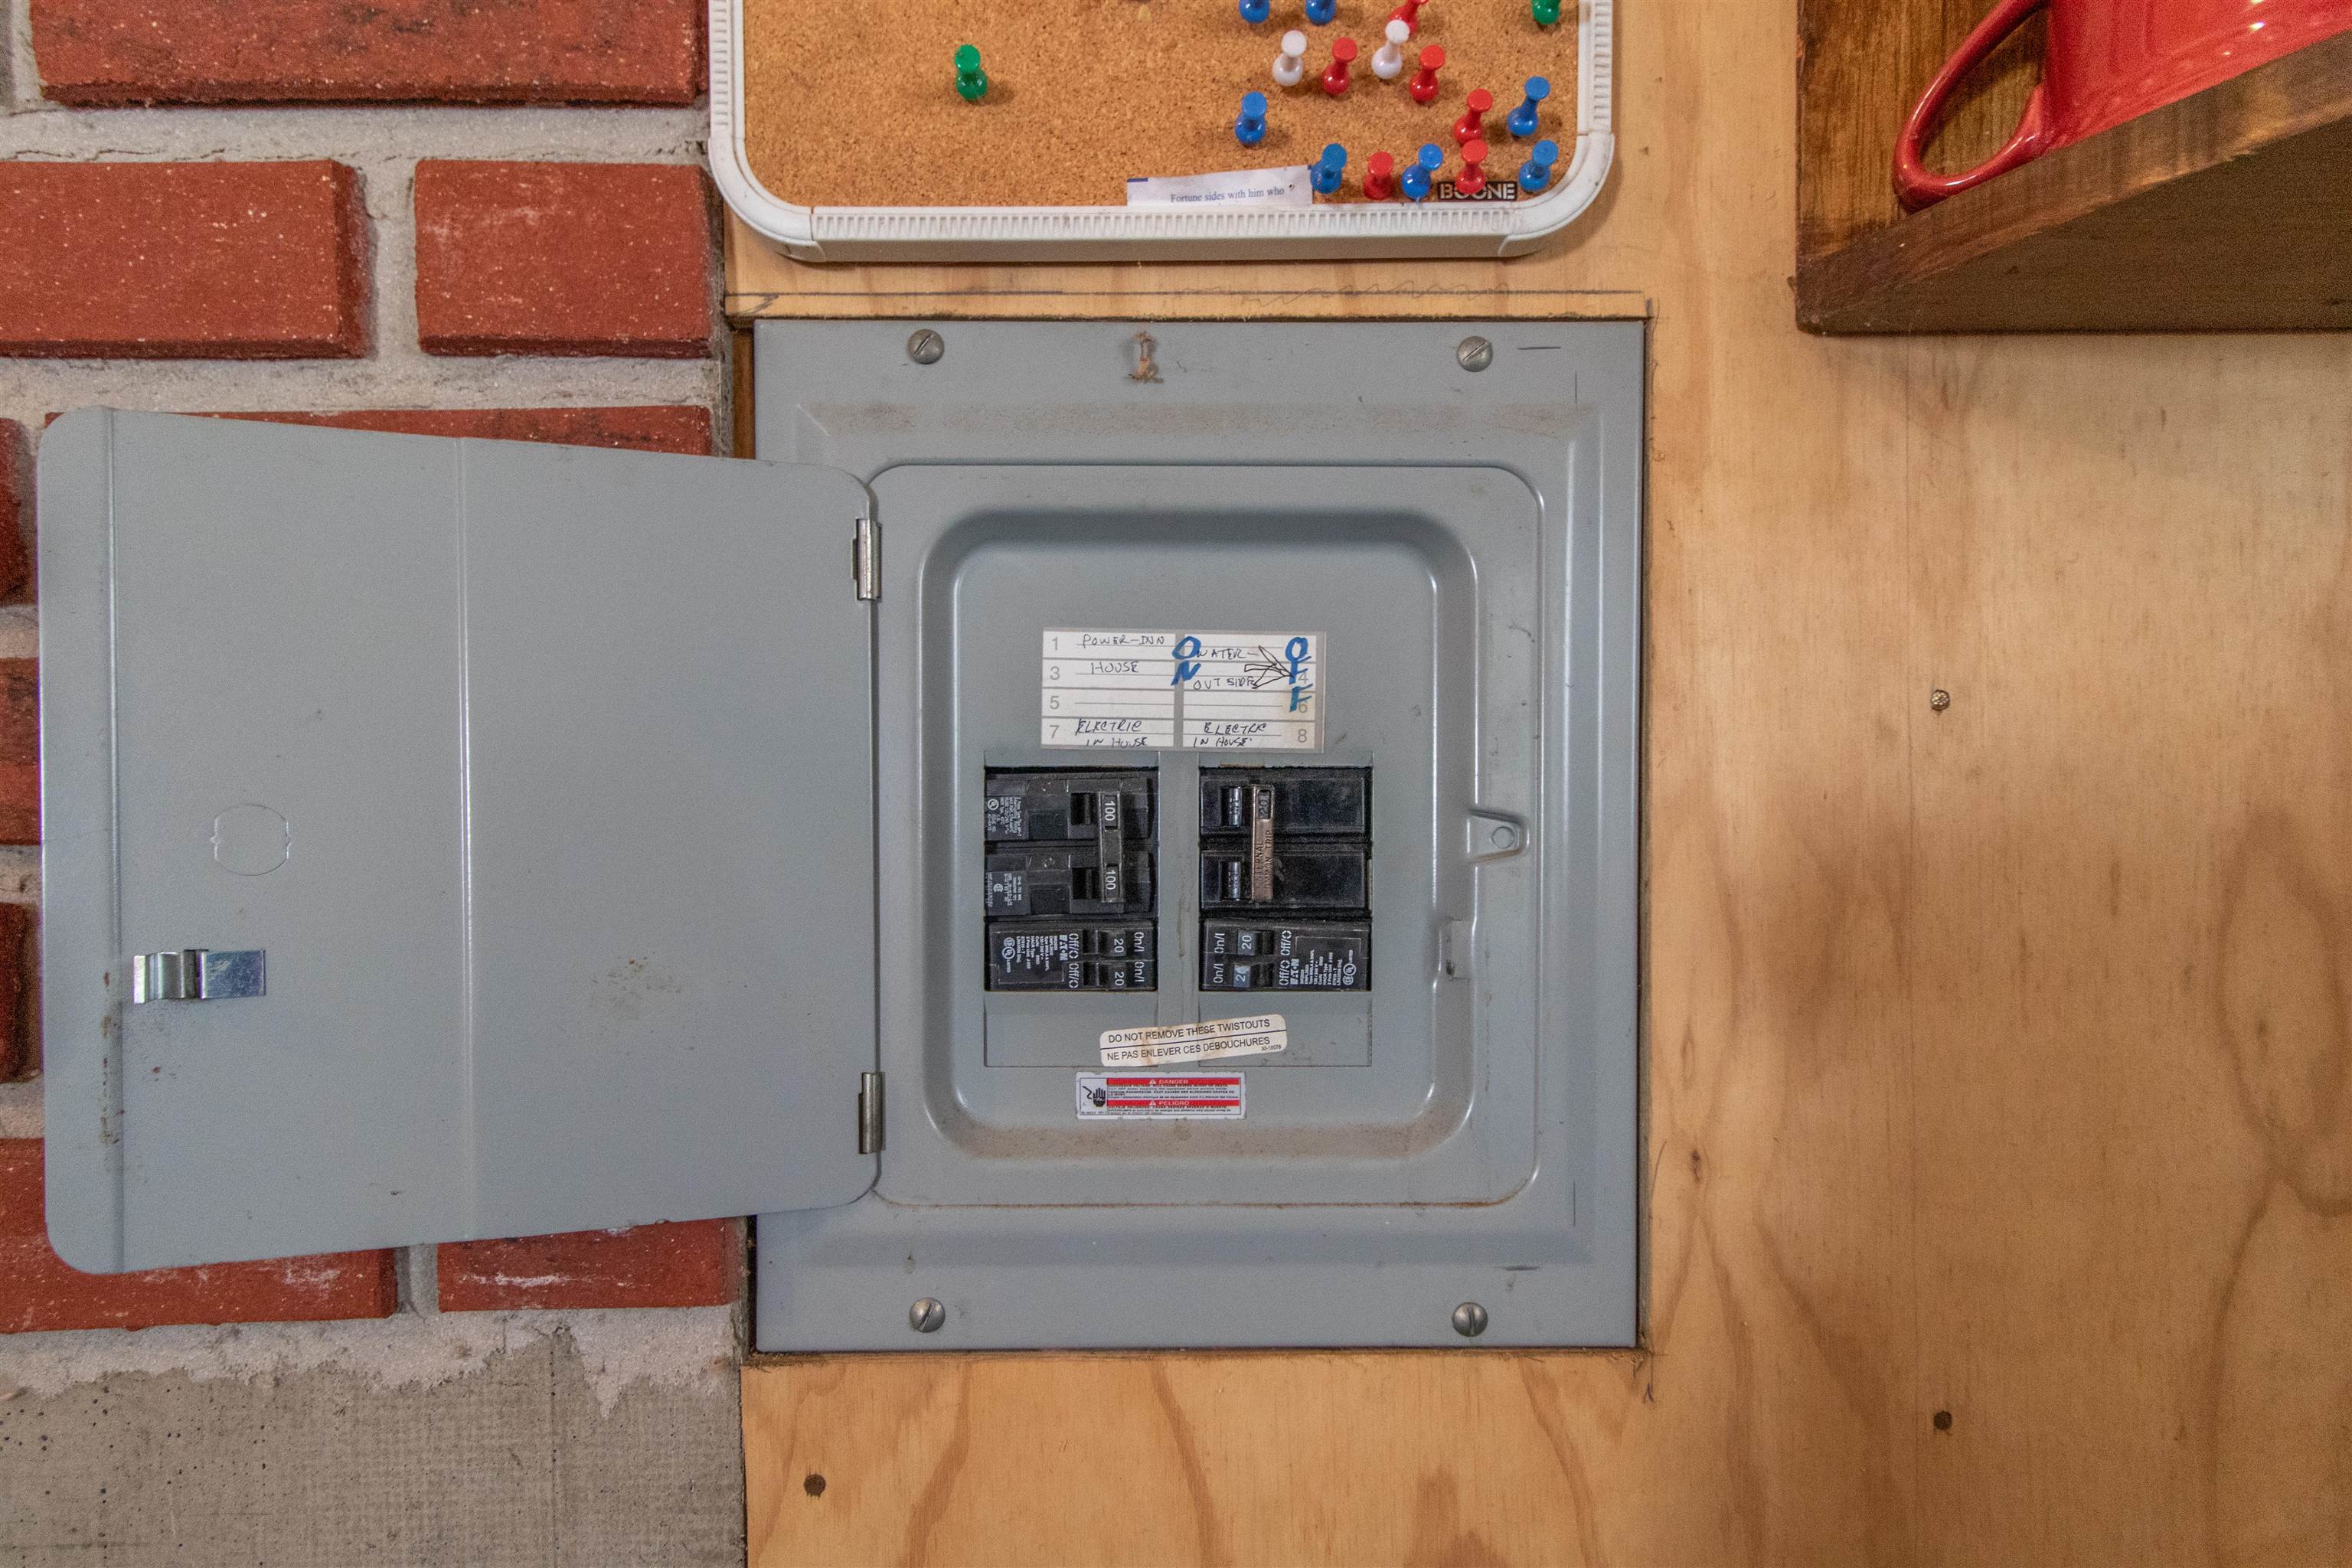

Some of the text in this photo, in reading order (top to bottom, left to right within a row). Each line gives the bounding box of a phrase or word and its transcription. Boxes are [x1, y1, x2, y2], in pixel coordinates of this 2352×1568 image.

[1170, 186, 1285, 203] Fortune sides with him who
[1052, 637, 1058, 651] 1
[1196, 648, 1247, 660] WATER
[1050, 666, 1060, 681] 3
[1091, 661, 1139, 675] HOUSE
[1297, 671, 1308, 684] 4
[1049, 695, 1060, 710] 5
[1049, 724, 1060, 740] 7
[1297, 728, 1308, 743] 8
[1086, 737, 1148, 748] IN HOUSE
[1194, 737, 1209, 747] IN
[1104, 801, 1116, 822] 100
[1264, 829, 1272, 849] TRIP
[1105, 870, 1116, 890] 100
[1114, 938, 1125, 954] 20
[1241, 935, 1253, 950] 20
[1115, 971, 1125, 986] 20
[1108, 1019, 1271, 1044] DO NOT REMOVE THESE TWISTOUTS
[1107, 1037, 1271, 1060] NE PAS ENLEVER CES DEBOUCHURES
